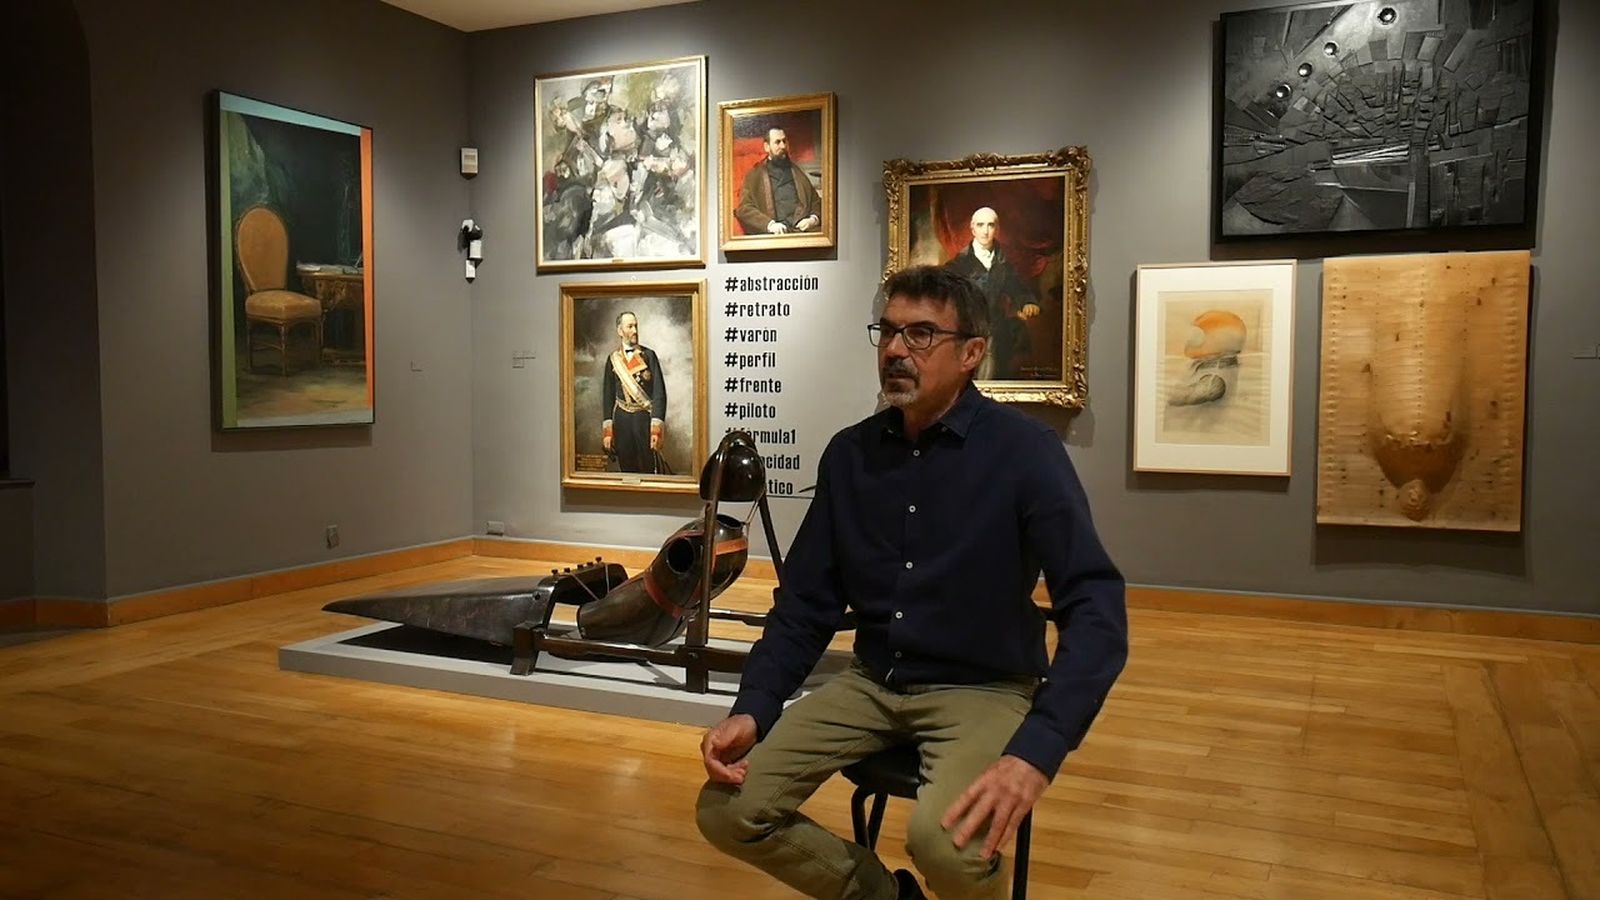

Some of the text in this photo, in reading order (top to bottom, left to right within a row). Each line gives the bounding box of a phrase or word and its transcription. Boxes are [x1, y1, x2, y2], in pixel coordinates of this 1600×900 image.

[724, 274, 818, 292] #abstracción
[724, 302, 791, 317] #retrato
[724, 326, 777, 342] #varón
[724, 352, 776, 370] #perfil
[724, 377, 782, 393] #frente
[724, 402, 776, 420] #piloto
[724, 427, 796, 444] rmula1
